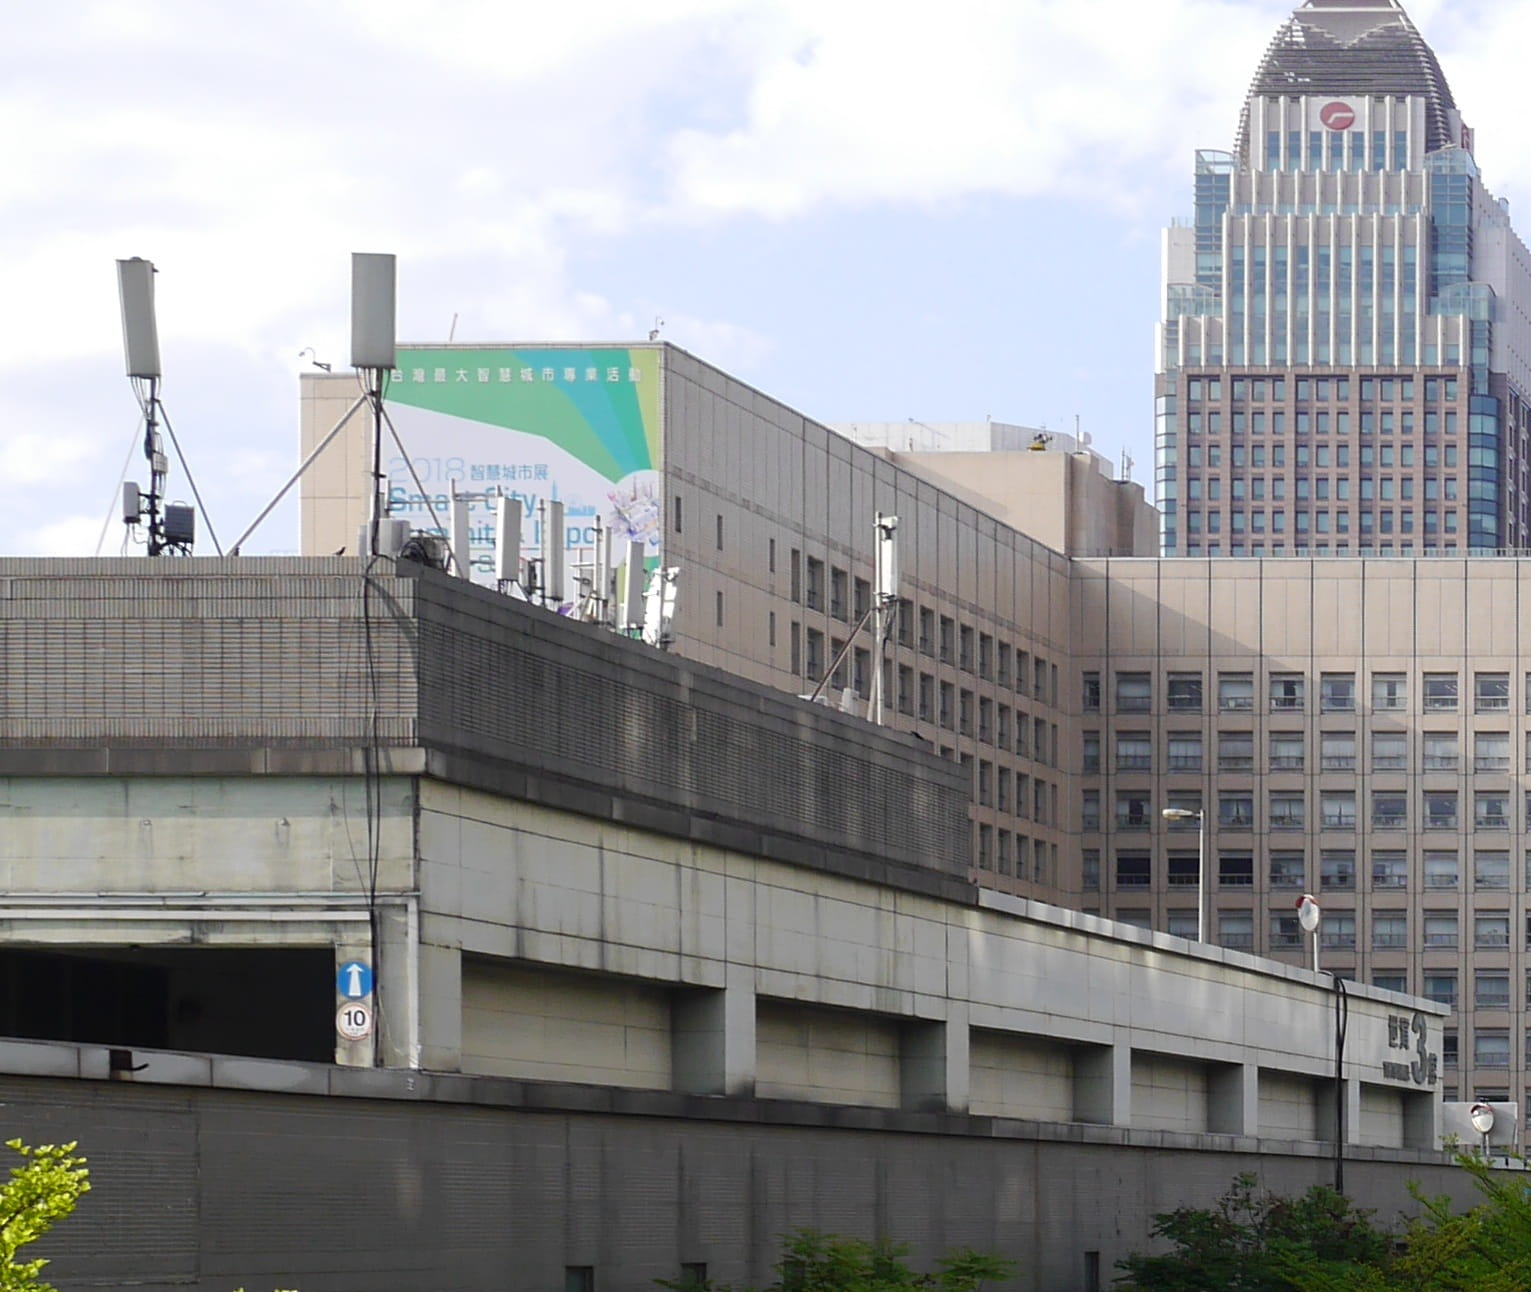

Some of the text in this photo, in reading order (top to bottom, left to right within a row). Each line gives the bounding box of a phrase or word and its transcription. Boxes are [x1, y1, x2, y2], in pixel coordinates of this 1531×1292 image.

[388, 457, 548, 482] 2018 智慧城市展
[344, 1010, 366, 1026] 10
